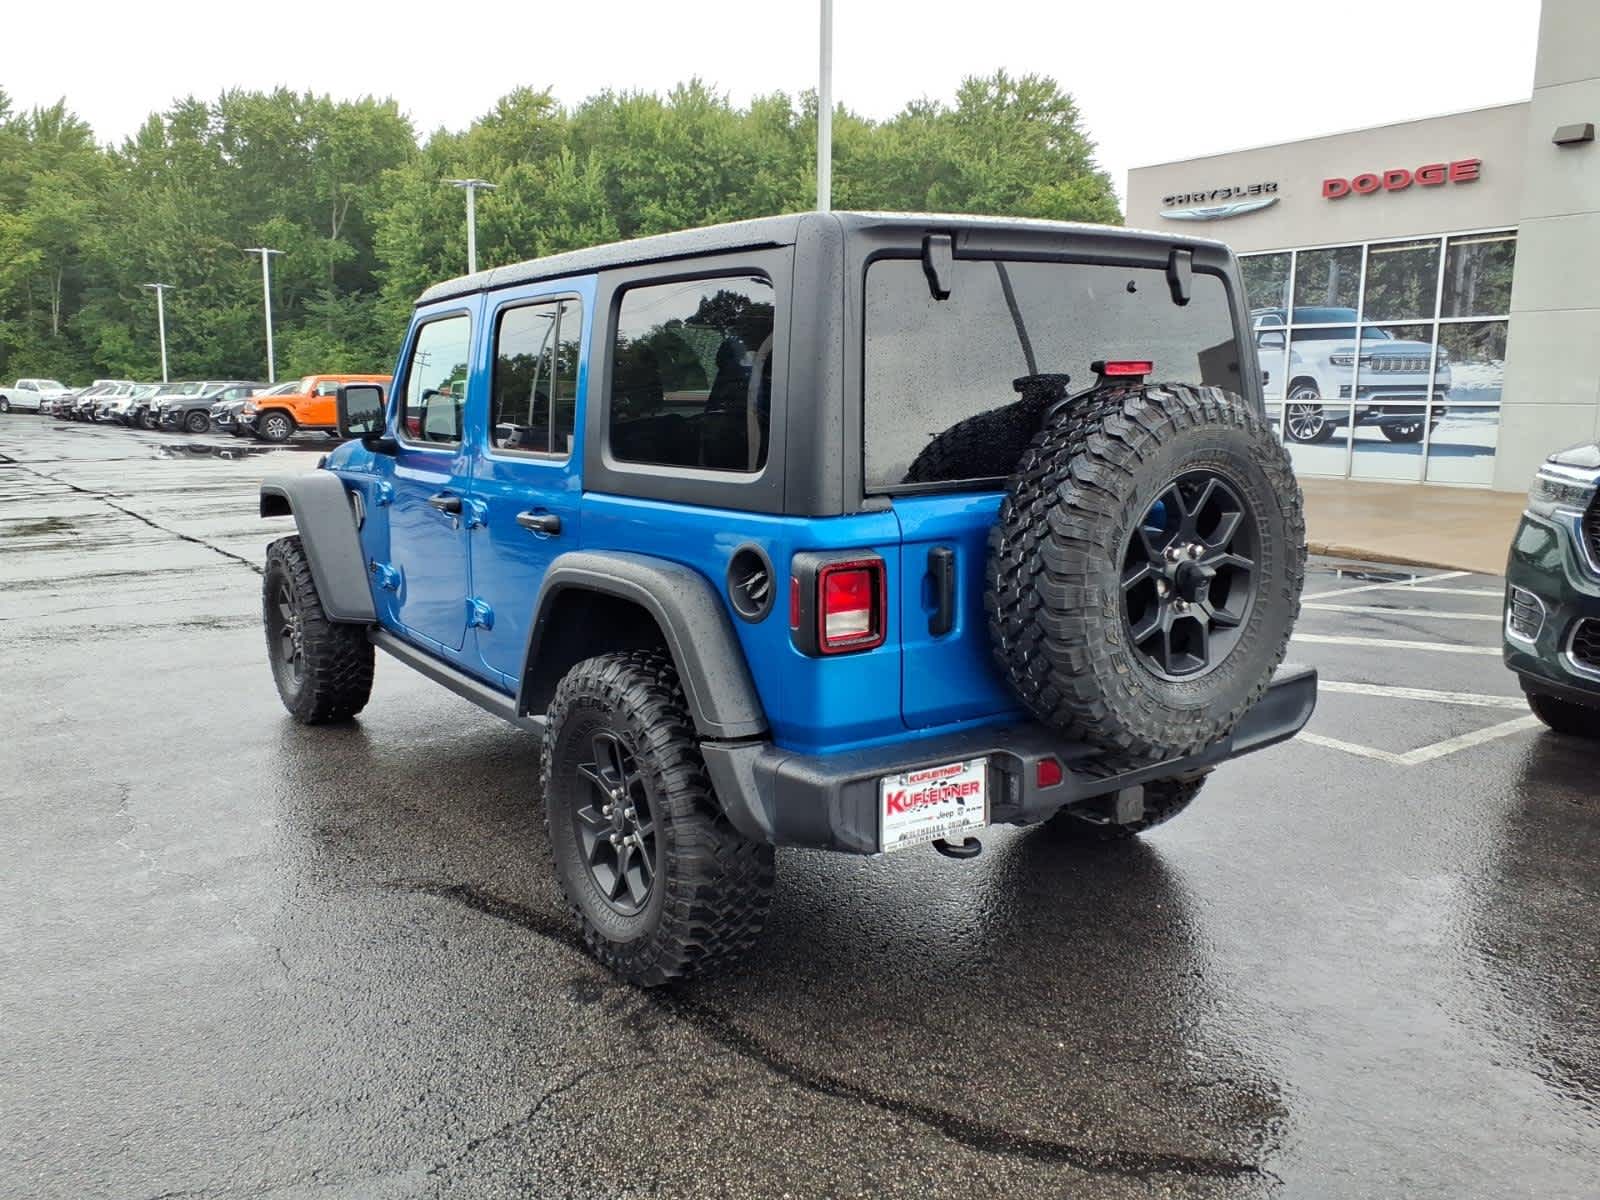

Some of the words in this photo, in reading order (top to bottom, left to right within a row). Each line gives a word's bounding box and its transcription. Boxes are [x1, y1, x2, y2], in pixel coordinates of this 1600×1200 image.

[1322, 158, 1482, 199] DODGE
[1162, 181, 1279, 206] CHRYSLER
[909, 765, 962, 783] KUFLEITNER
